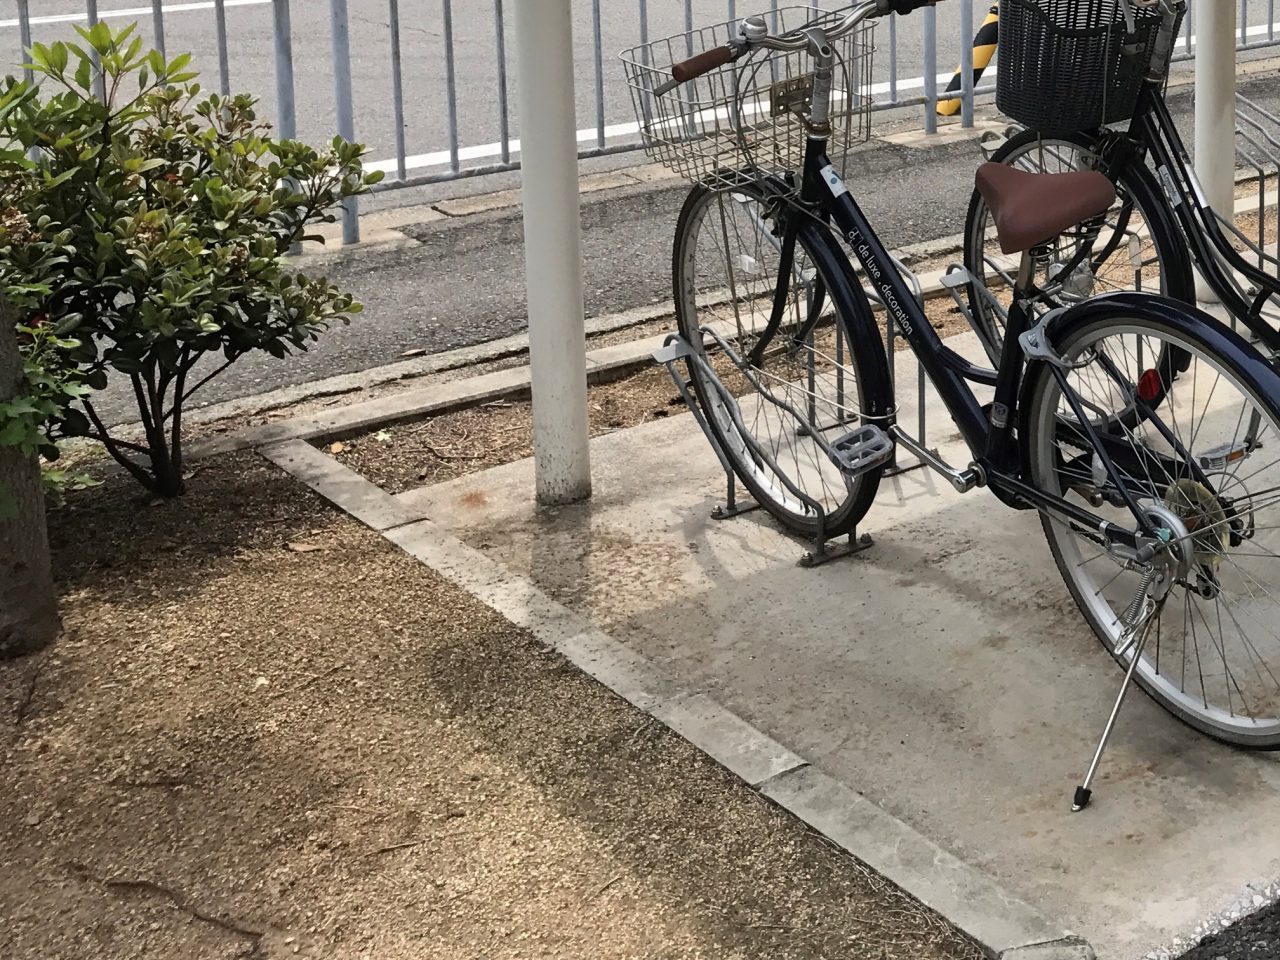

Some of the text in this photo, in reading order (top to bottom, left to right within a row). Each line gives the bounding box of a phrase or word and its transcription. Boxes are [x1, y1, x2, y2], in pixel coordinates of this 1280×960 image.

[858, 244, 869, 258] de
[865, 255, 881, 279] luxe
[881, 284, 914, 336] decoration
